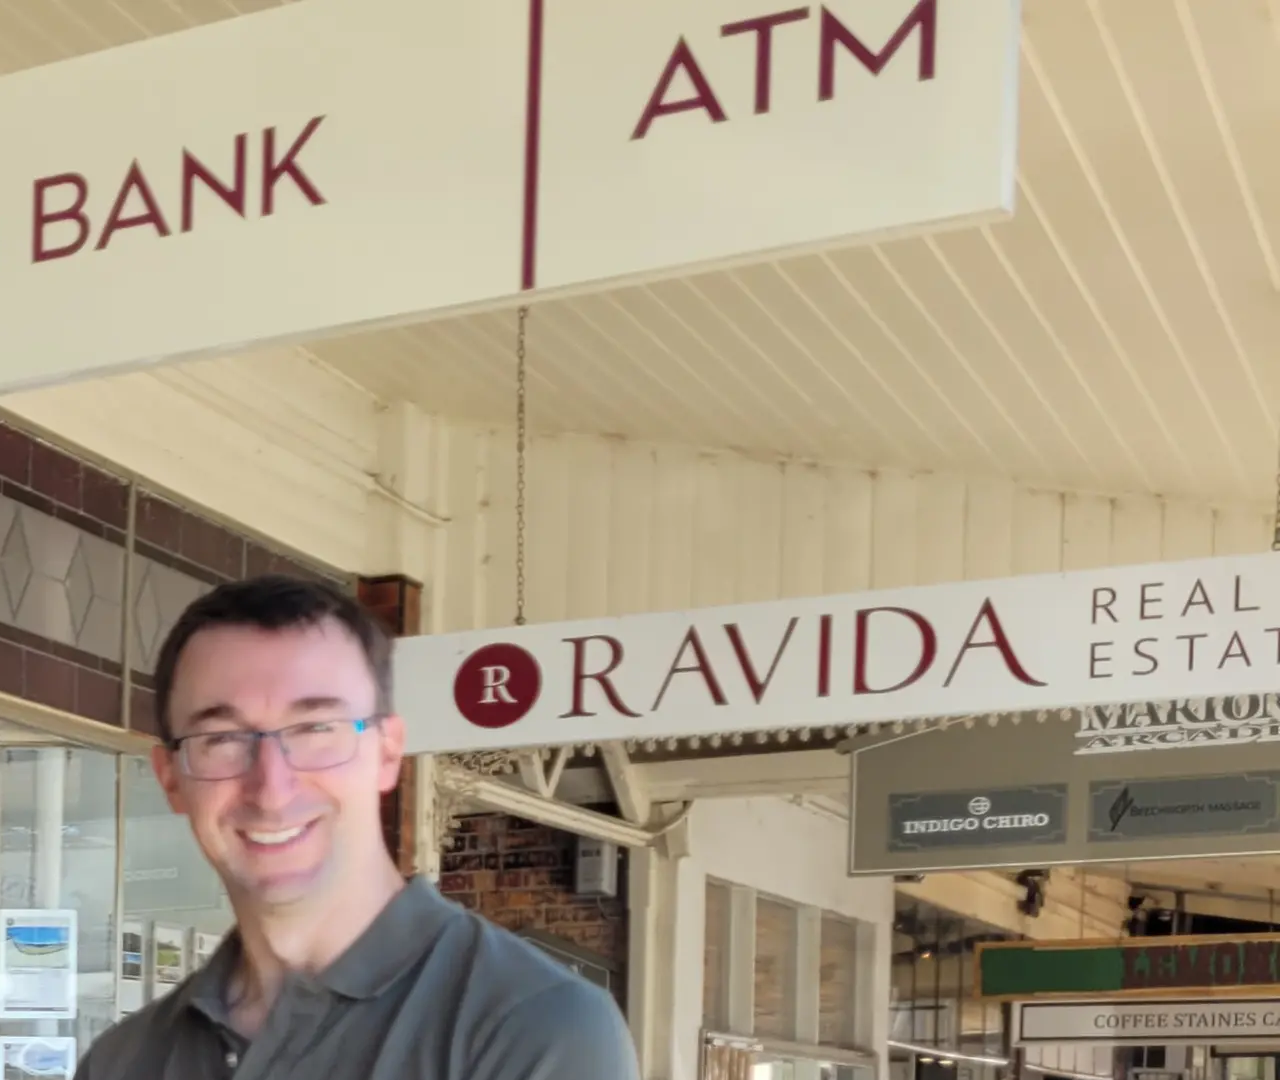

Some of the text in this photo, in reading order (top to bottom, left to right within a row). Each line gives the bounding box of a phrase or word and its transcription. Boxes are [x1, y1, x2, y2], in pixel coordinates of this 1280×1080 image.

[629, 0, 938, 141] ATM
[31, 114, 328, 264] BANK
[1091, 574, 1261, 625] REAL
[557, 596, 1049, 719] RAVIDA
[903, 813, 1050, 835] INDIGO CHIRO
[1093, 1013, 1168, 1030] COFFEE
[1173, 1011, 1257, 1028] STAINES
